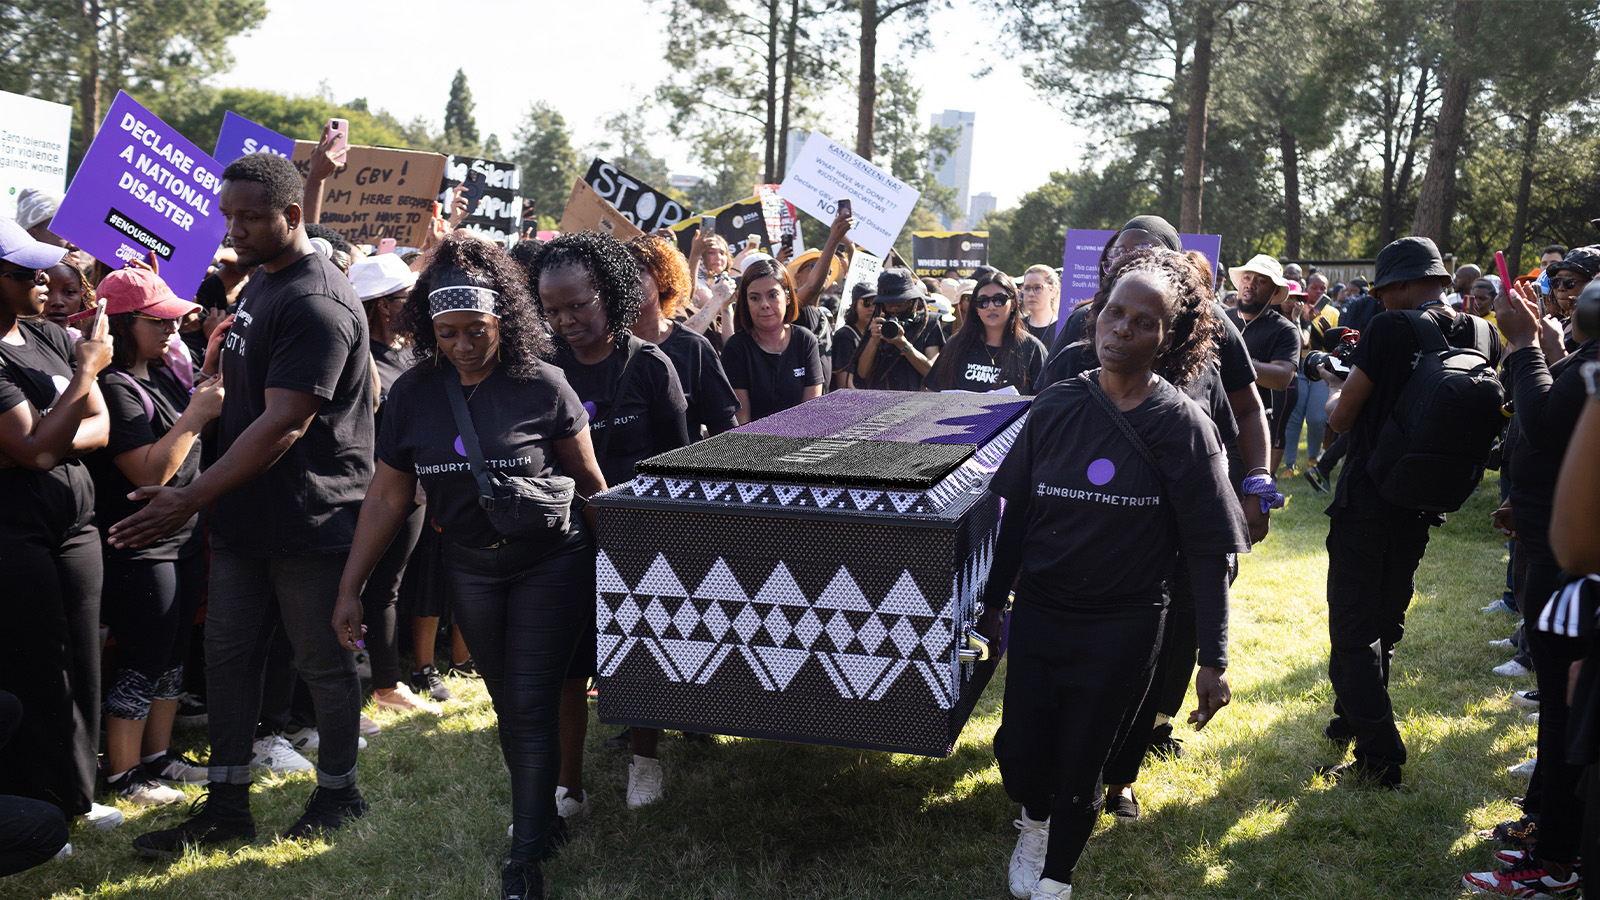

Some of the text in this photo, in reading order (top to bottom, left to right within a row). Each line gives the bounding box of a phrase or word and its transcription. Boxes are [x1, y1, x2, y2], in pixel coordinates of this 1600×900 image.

[2, 130, 61, 151] Zero tolerance
[2, 142, 59, 163] for violence
[120, 112, 222, 195] DECLARE GBV
[0, 157, 64, 175] gainst women
[829, 144, 903, 191] KANTI SENZENI NA?
[119, 144, 211, 217] A NATIONAL
[815, 157, 835, 173] WHAT
[836, 168, 853, 181] HAVE
[854, 178, 865, 190] WE
[865, 185, 883, 201] DONE
[118, 171, 195, 232] DISASTER
[325, 189, 351, 205] AM
[360, 192, 393, 206] HERE
[793, 174, 818, 193] Declare
[819, 189, 834, 201] GBV
[866, 218, 892, 238] Disaster
[406, 211, 422, 224] TO
[109, 214, 171, 257] #ENOUGHSAID
[916, 269, 931, 277] SEX
[917, 259, 947, 267] WHERE
[961, 260, 982, 268] THE
[967, 363, 993, 373] WOMEN
[1036, 482, 1159, 506] #UNBURYTHETRUTH
